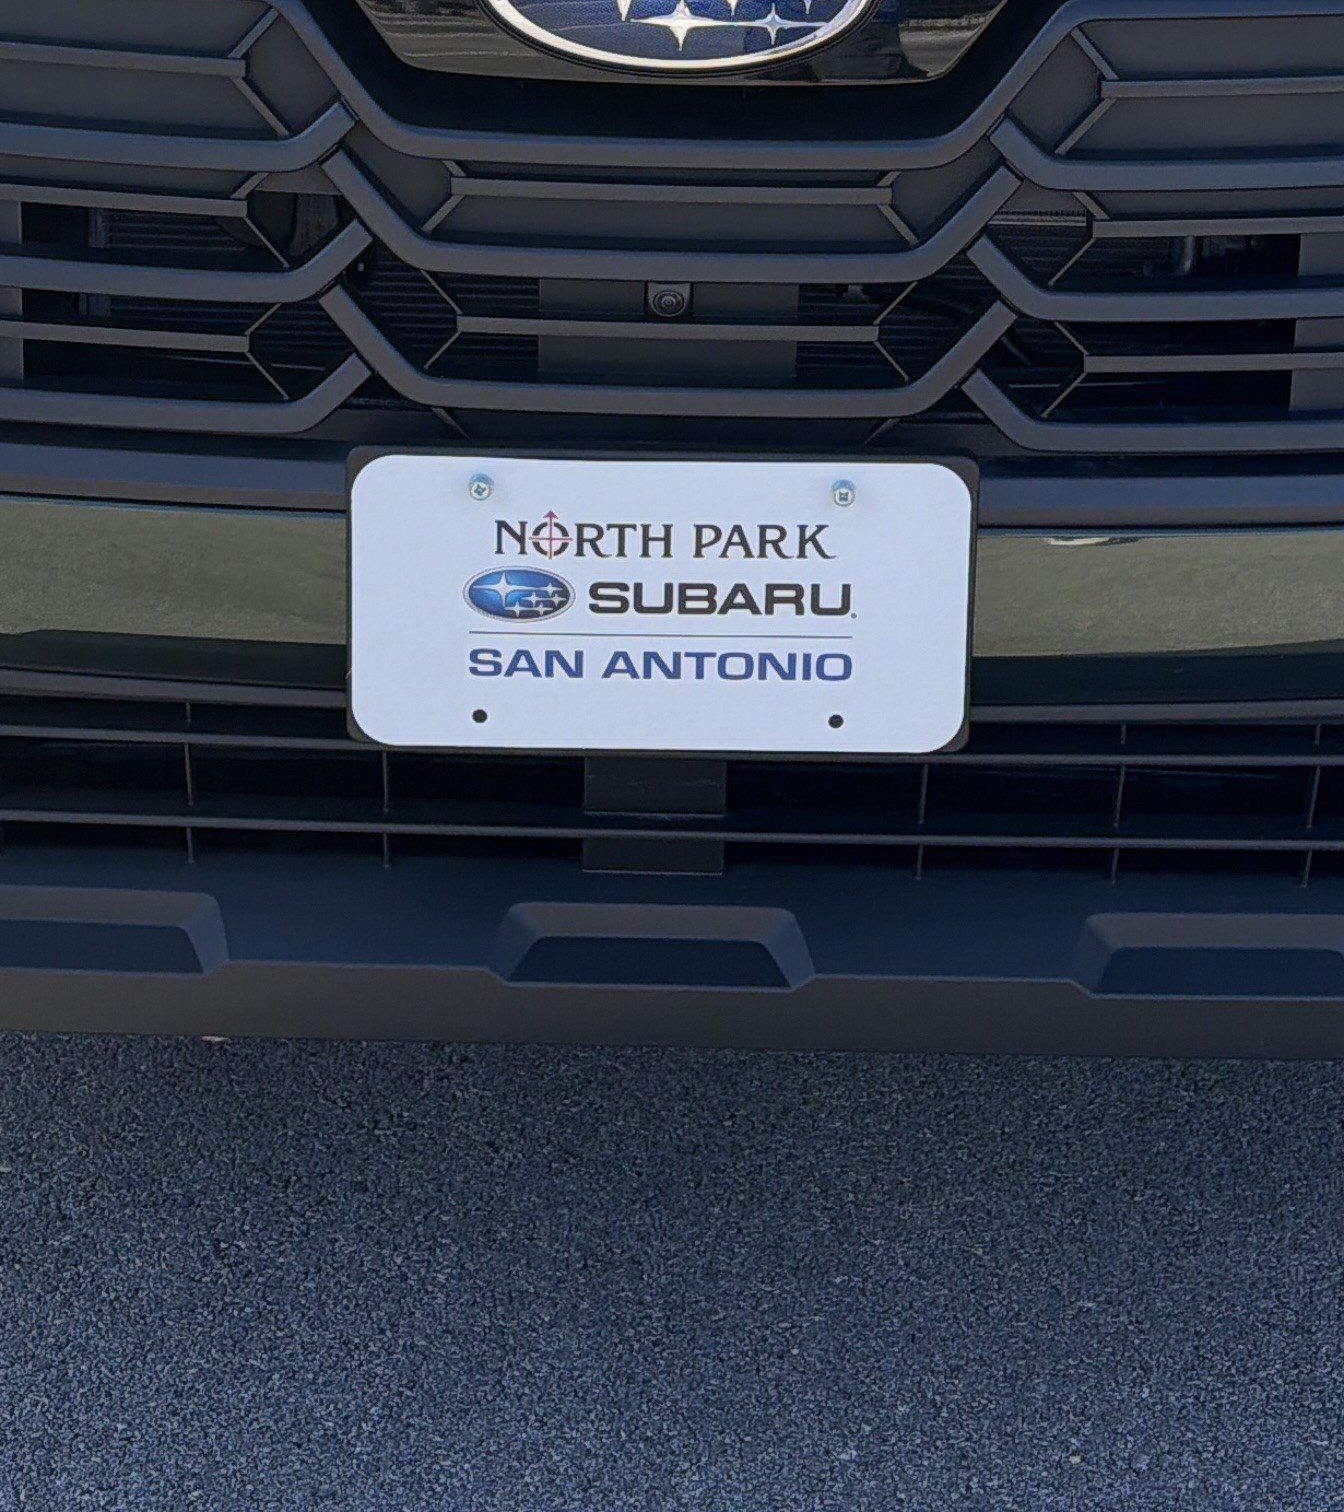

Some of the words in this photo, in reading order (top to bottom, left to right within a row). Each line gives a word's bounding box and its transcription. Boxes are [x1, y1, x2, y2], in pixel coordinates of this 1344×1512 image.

[495, 514, 673, 560] NORTH
[693, 522, 837, 560] PARK
[588, 582, 852, 618] SUBARU
[468, 648, 584, 679] SAN
[602, 650, 853, 682] ANTONIO
